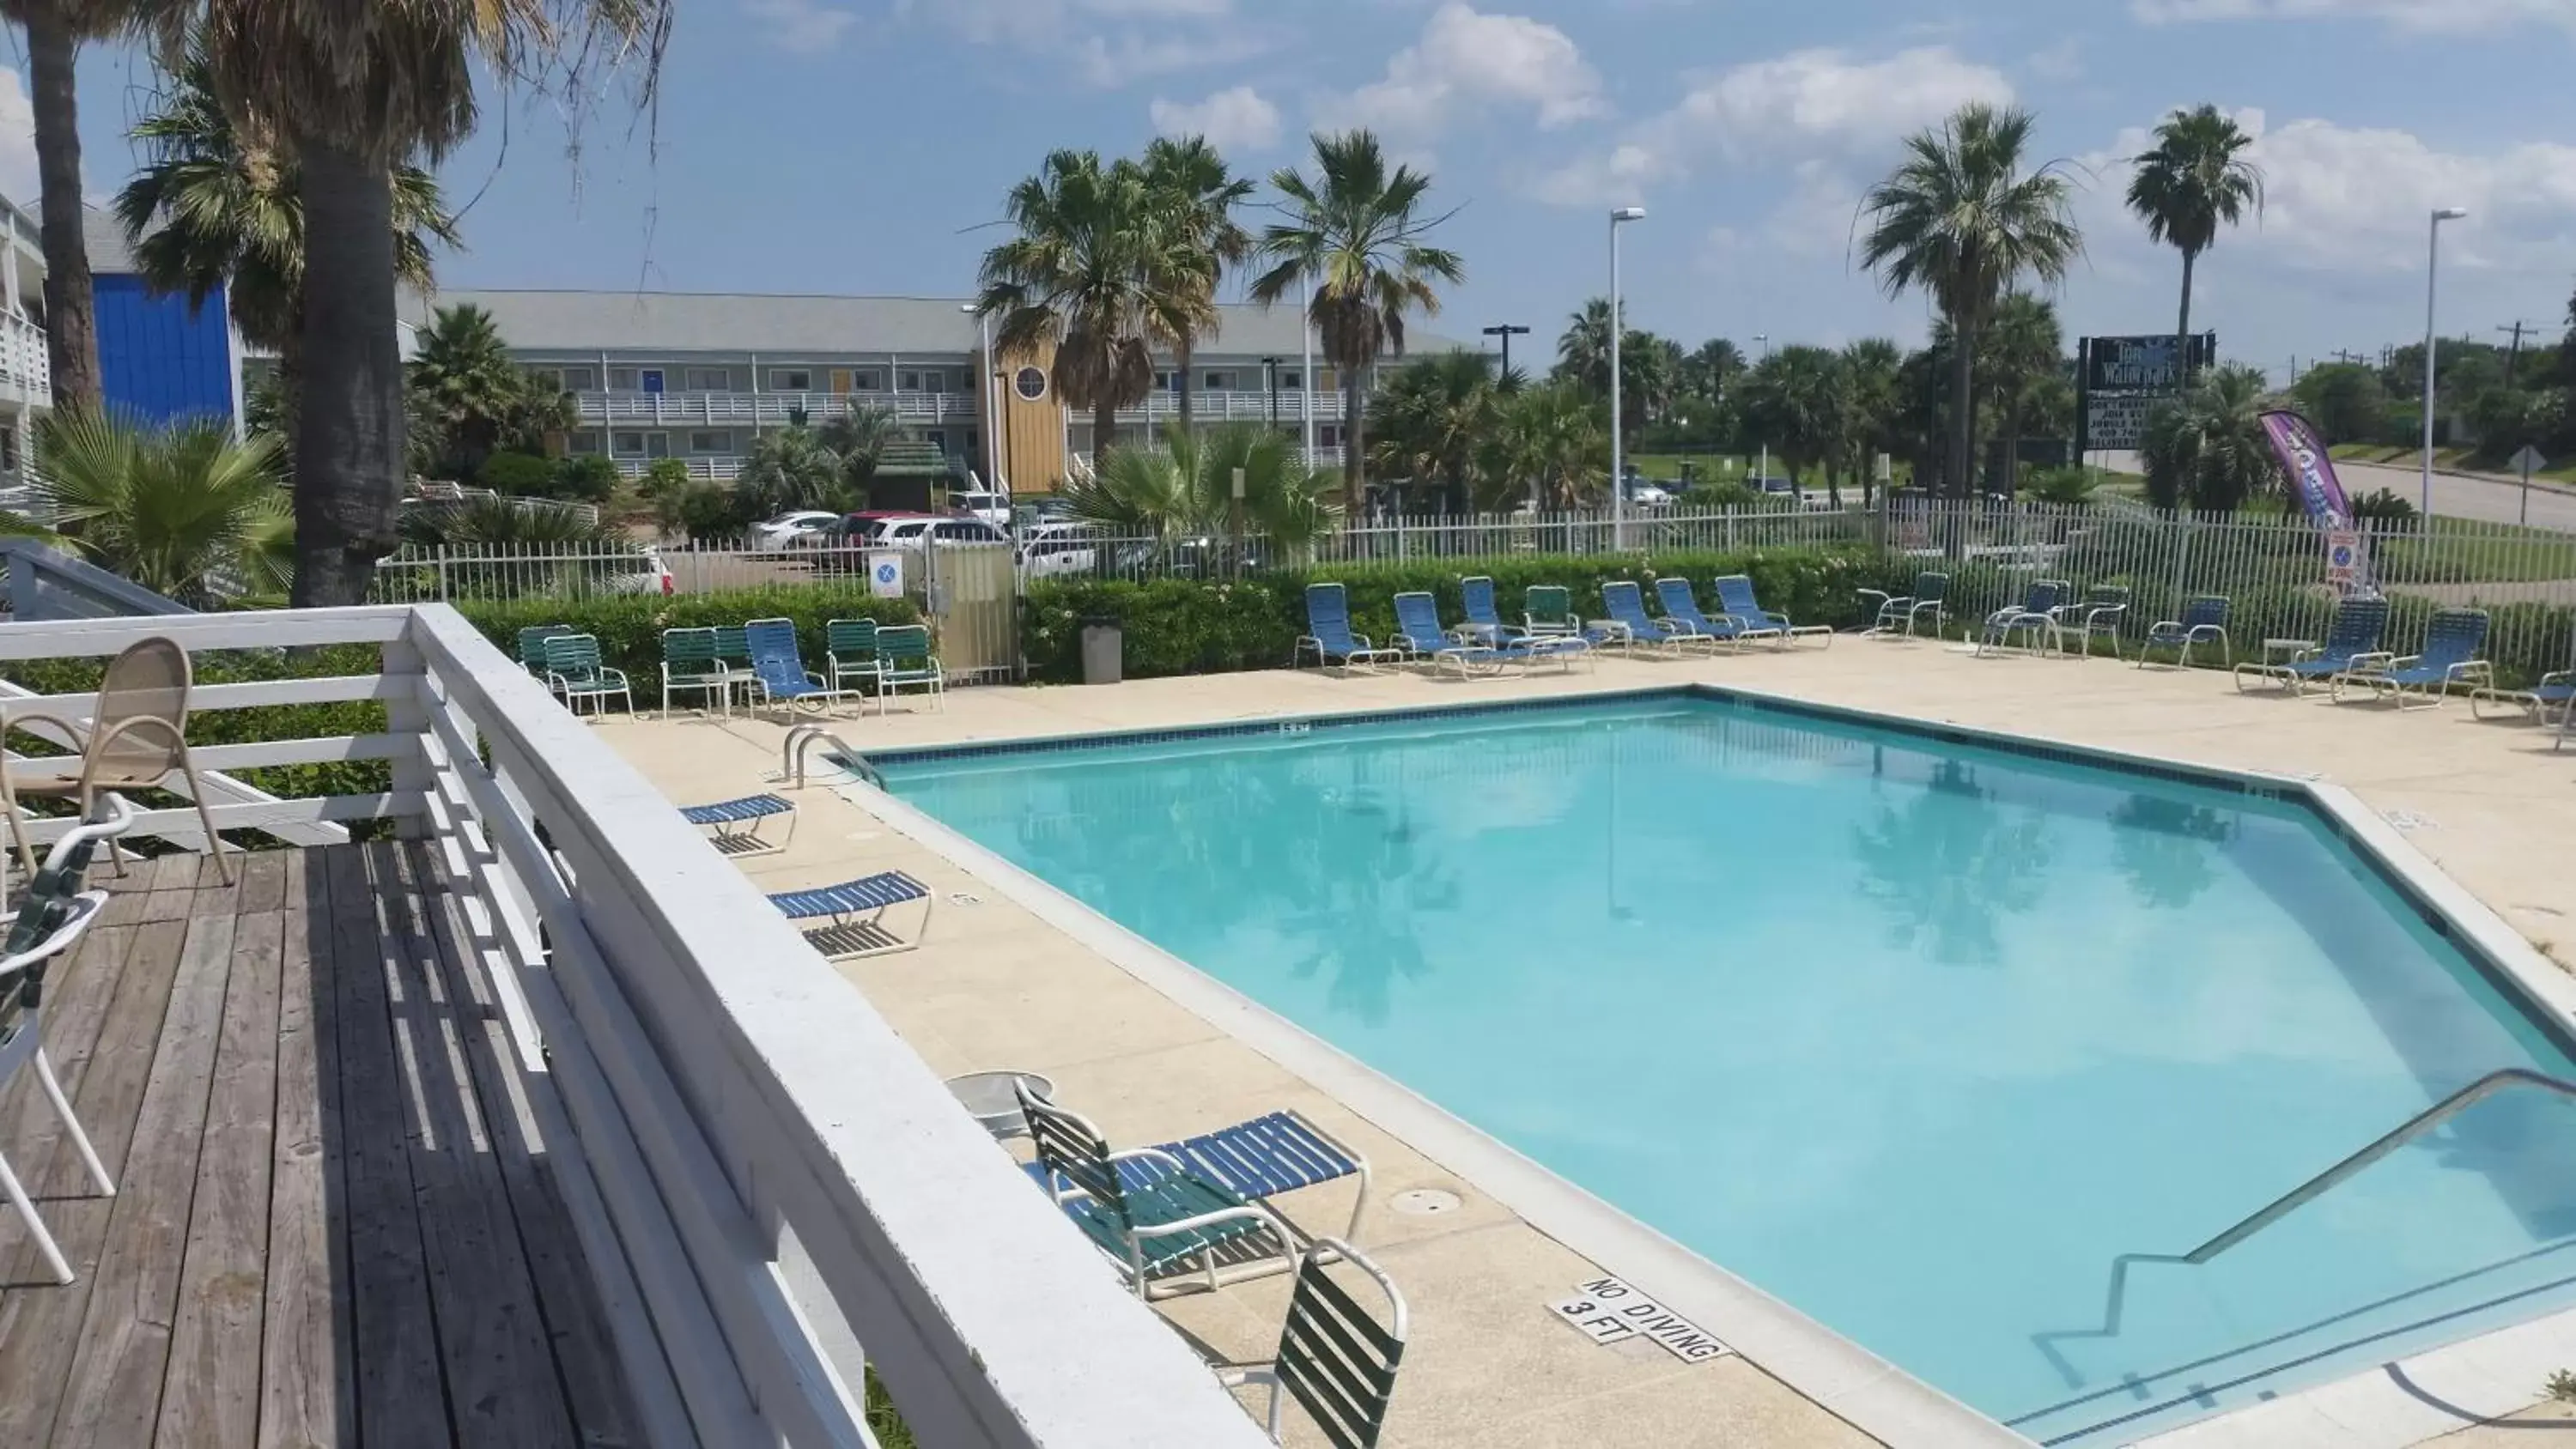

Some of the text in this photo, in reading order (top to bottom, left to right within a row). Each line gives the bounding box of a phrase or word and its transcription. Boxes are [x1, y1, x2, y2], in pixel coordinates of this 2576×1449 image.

[1562, 1301, 1633, 1337] 3 FT
[1582, 1278, 1720, 1358] NO DIVING
